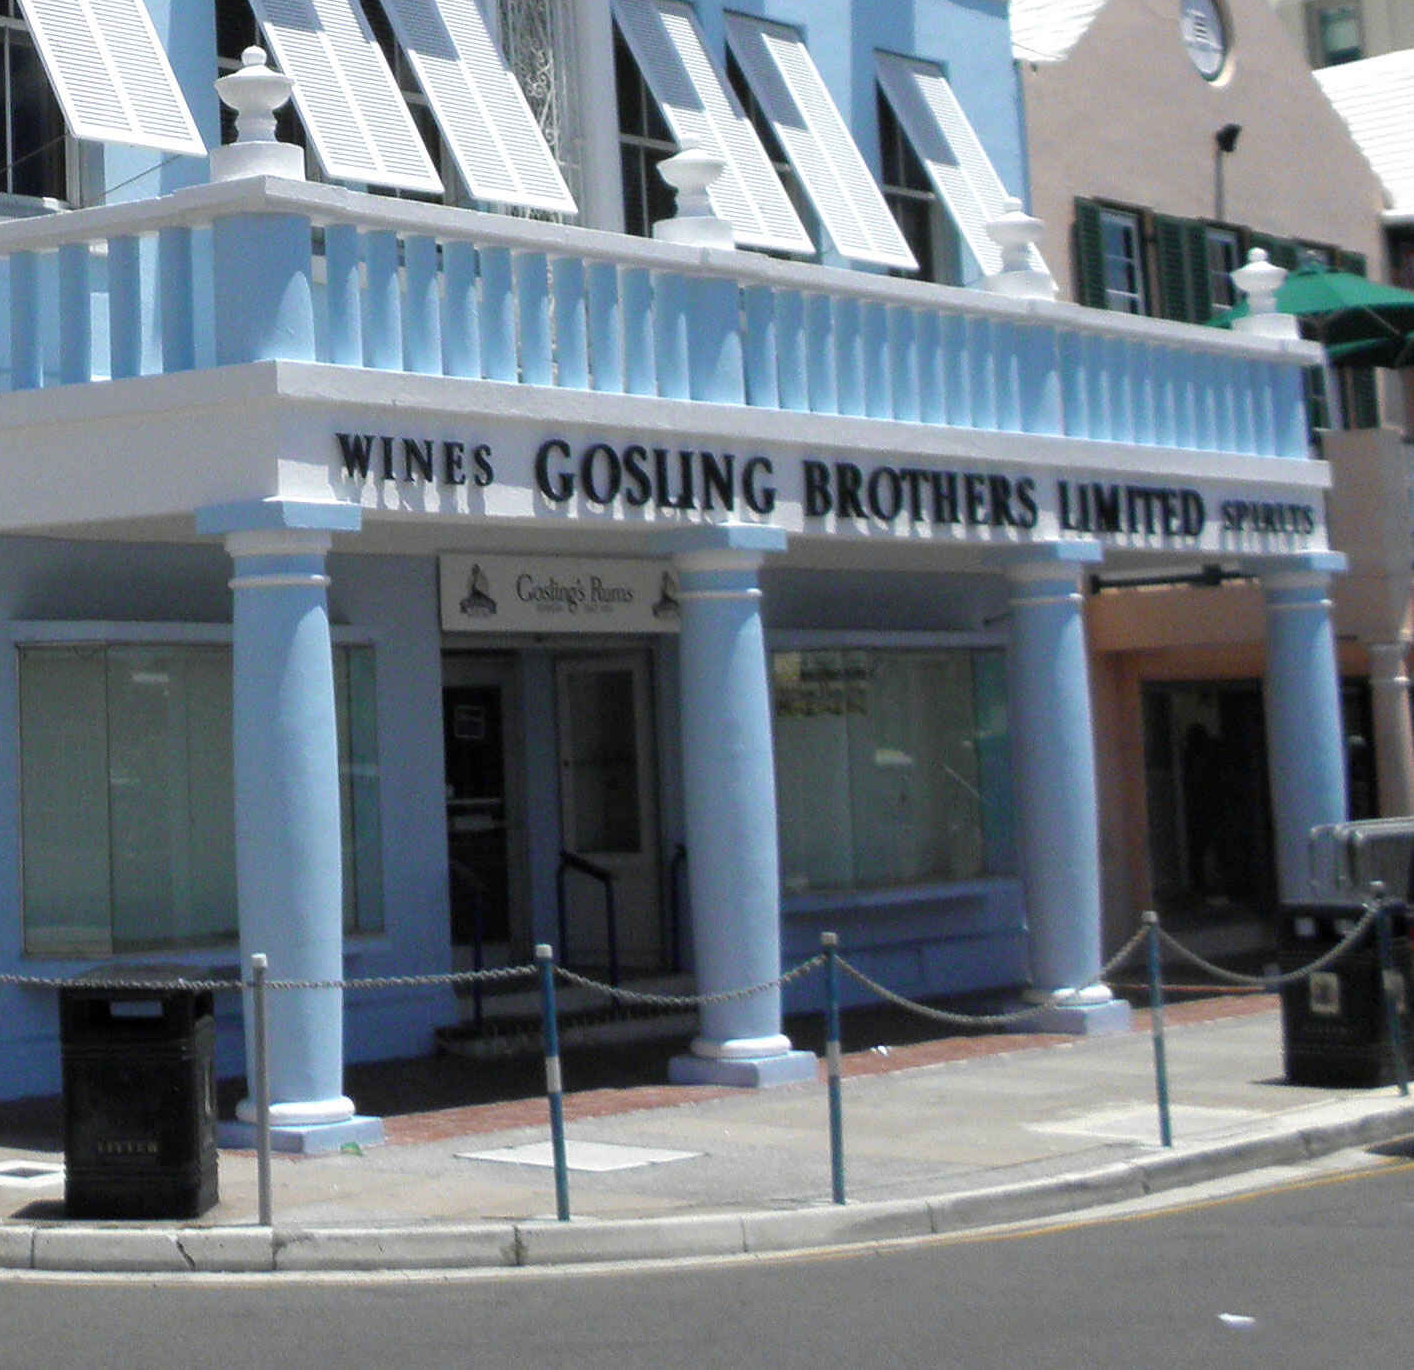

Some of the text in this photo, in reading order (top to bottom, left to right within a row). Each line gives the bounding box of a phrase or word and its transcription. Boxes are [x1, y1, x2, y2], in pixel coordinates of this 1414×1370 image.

[336, 432, 1316, 536] WINES GOSLING BROTHERS LIMITED SPIRITS
[516, 573, 634, 614] Gosling's Rums
